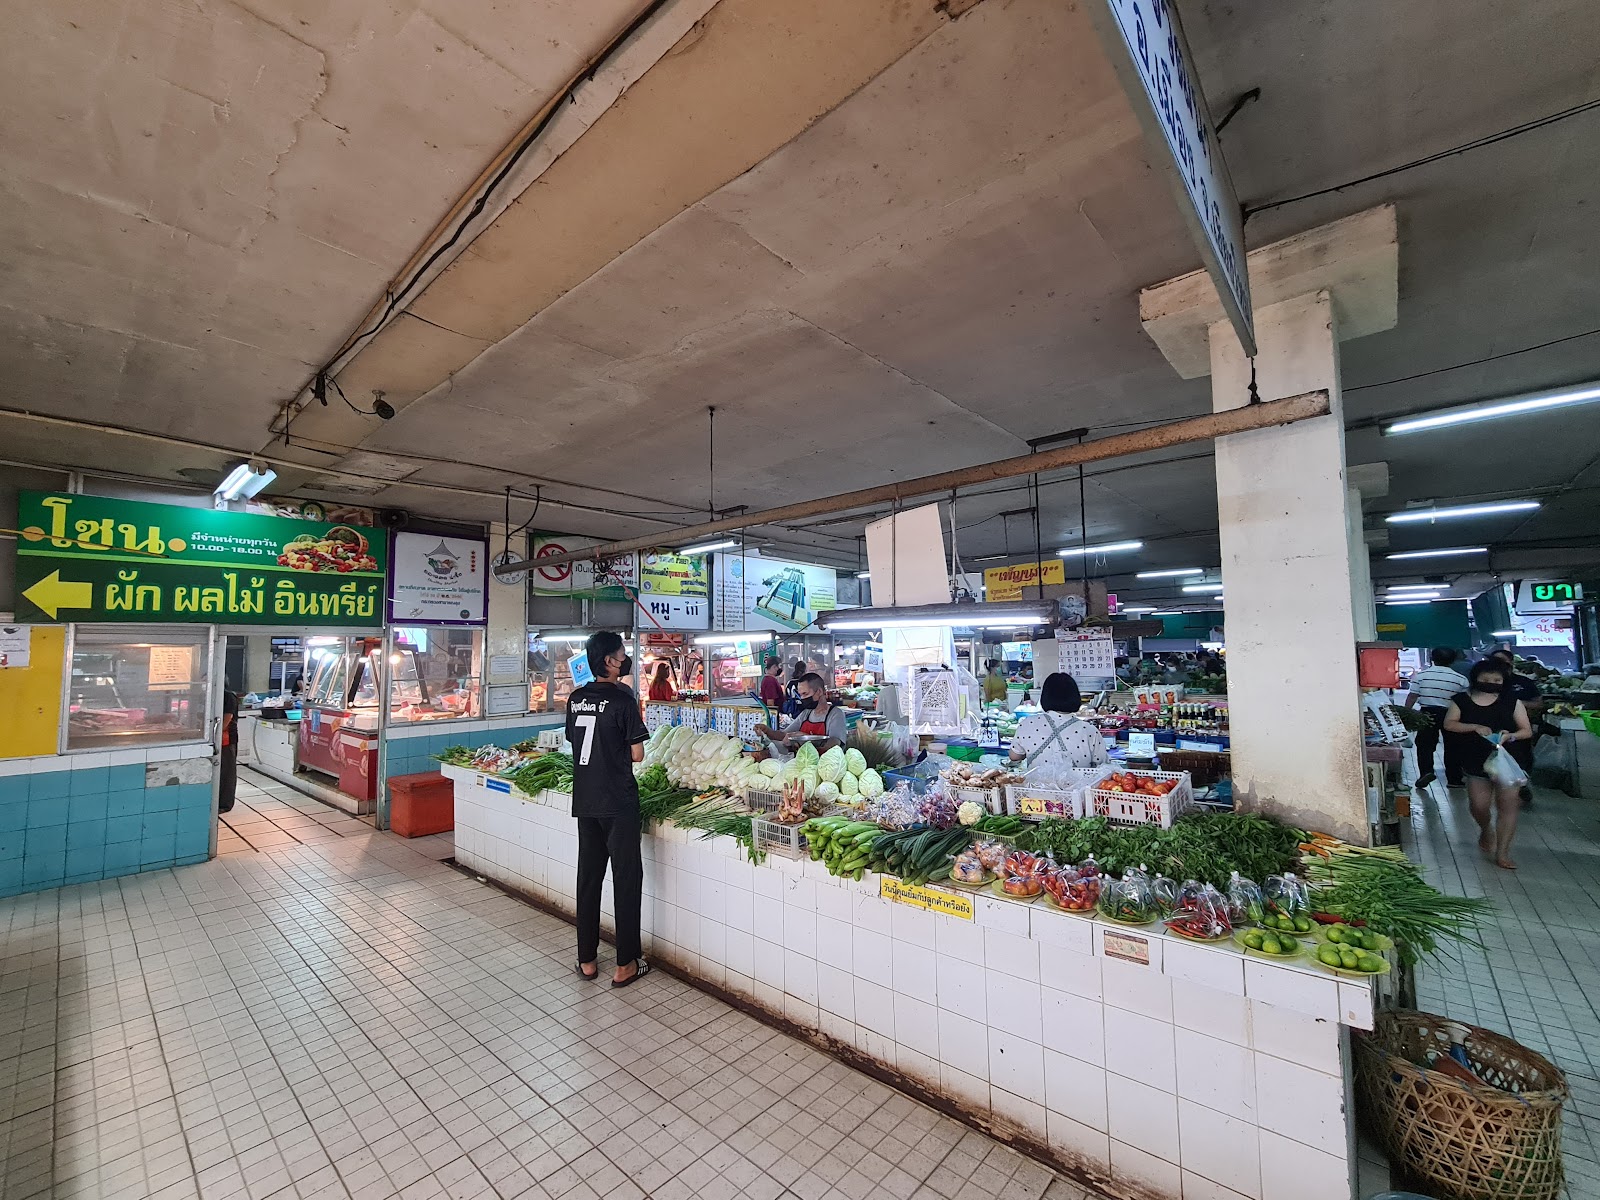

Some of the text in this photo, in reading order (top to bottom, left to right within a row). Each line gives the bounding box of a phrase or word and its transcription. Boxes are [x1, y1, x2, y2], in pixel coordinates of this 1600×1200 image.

[42, 496, 165, 555] โซน
[191, 532, 277, 547] มีจำหน่ายทุกวัน
[191, 543, 263, 555] 10.00-18.00
[105, 570, 378, 617] ผัก ผลไม้ อินทรีย์
[1535, 583, 1572, 600] ยา
[650, 601, 670, 621] หมู
[575, 715, 597, 766] 7
